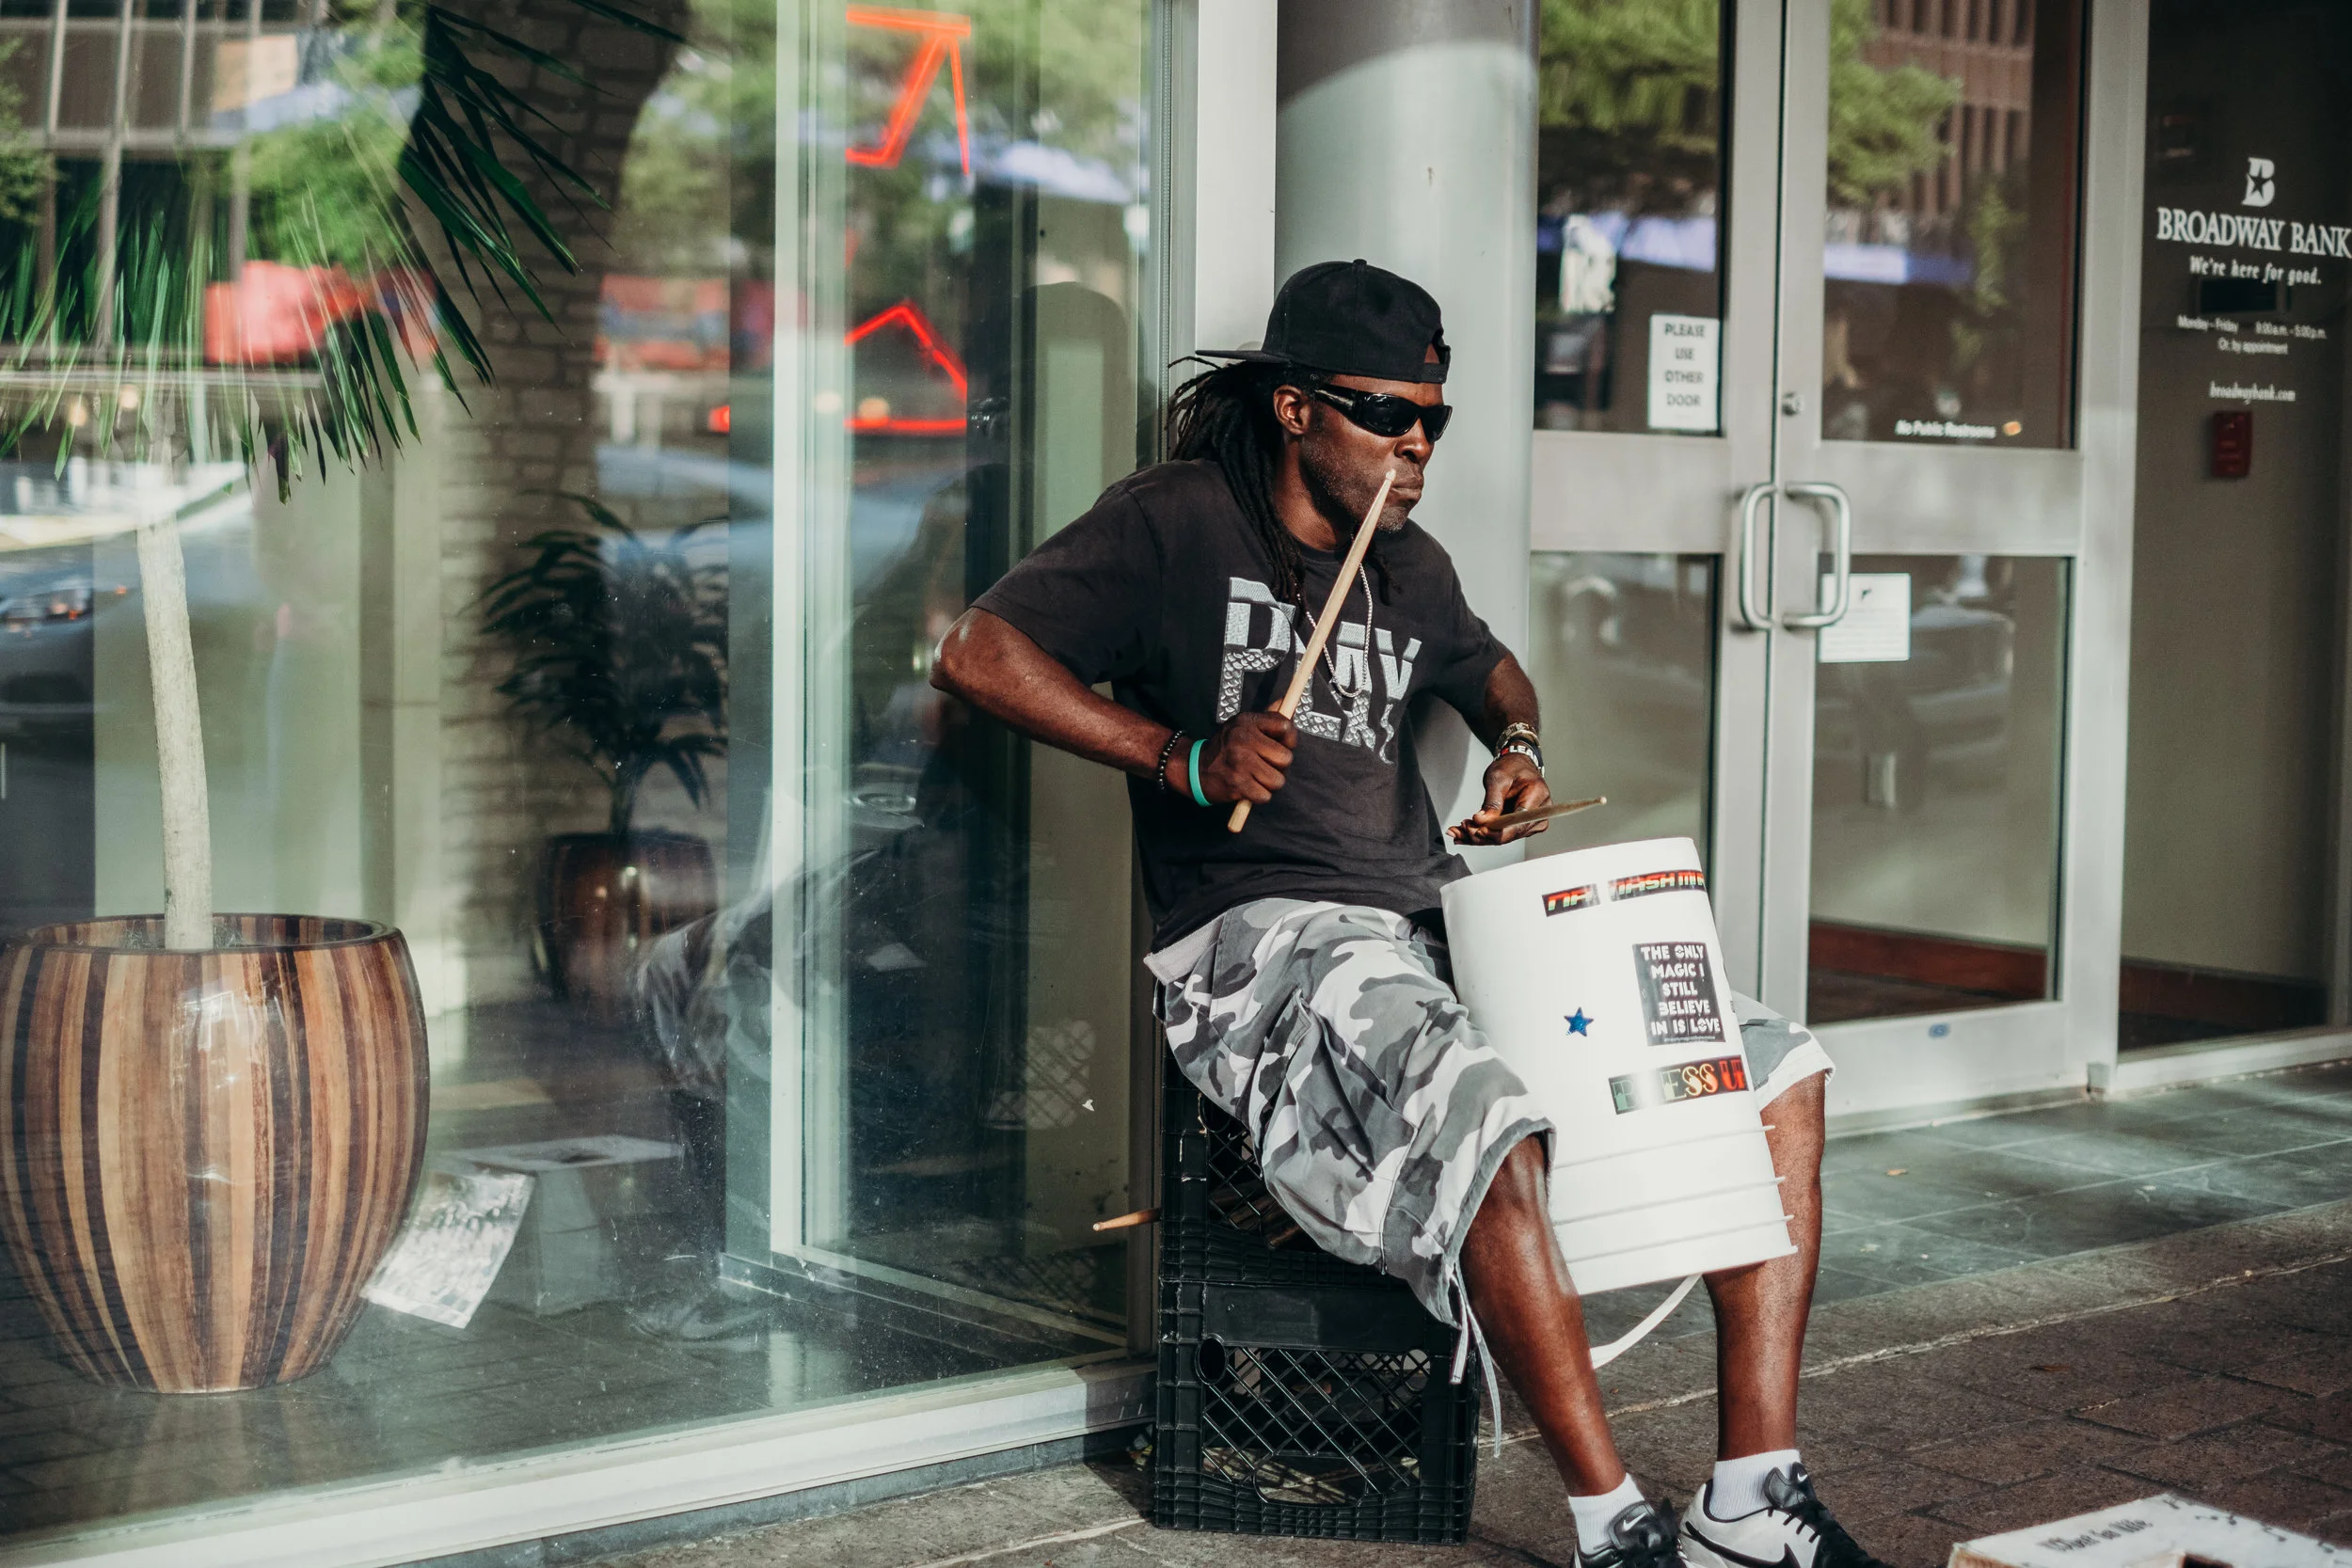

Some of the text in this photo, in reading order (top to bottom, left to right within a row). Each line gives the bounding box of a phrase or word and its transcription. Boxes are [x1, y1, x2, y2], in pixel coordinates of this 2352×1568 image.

[2156, 207, 2352, 260] BROADWAY BANK
[2189, 255, 2323, 287] We're here for good.
[1663, 323, 1707, 338] PLEASE
[1675, 347, 1694, 360] USE
[2243, 341, 2288, 355] appointment
[1664, 370, 1706, 384] OTHER
[1666, 393, 1701, 406] DOOR
[2209, 380, 2296, 405] broadwaybank.com
[1216, 577, 1422, 765] PLAY
[1641, 944, 1705, 961] THE ONLY
[1651, 964, 1697, 979] MAGIC
[1661, 982, 1698, 998] STILL
[1659, 1000, 1711, 1017] BELIEVE
[1650, 1018, 1722, 1036] IN IS LOVE
[1612, 1063, 1719, 1112] BESS
